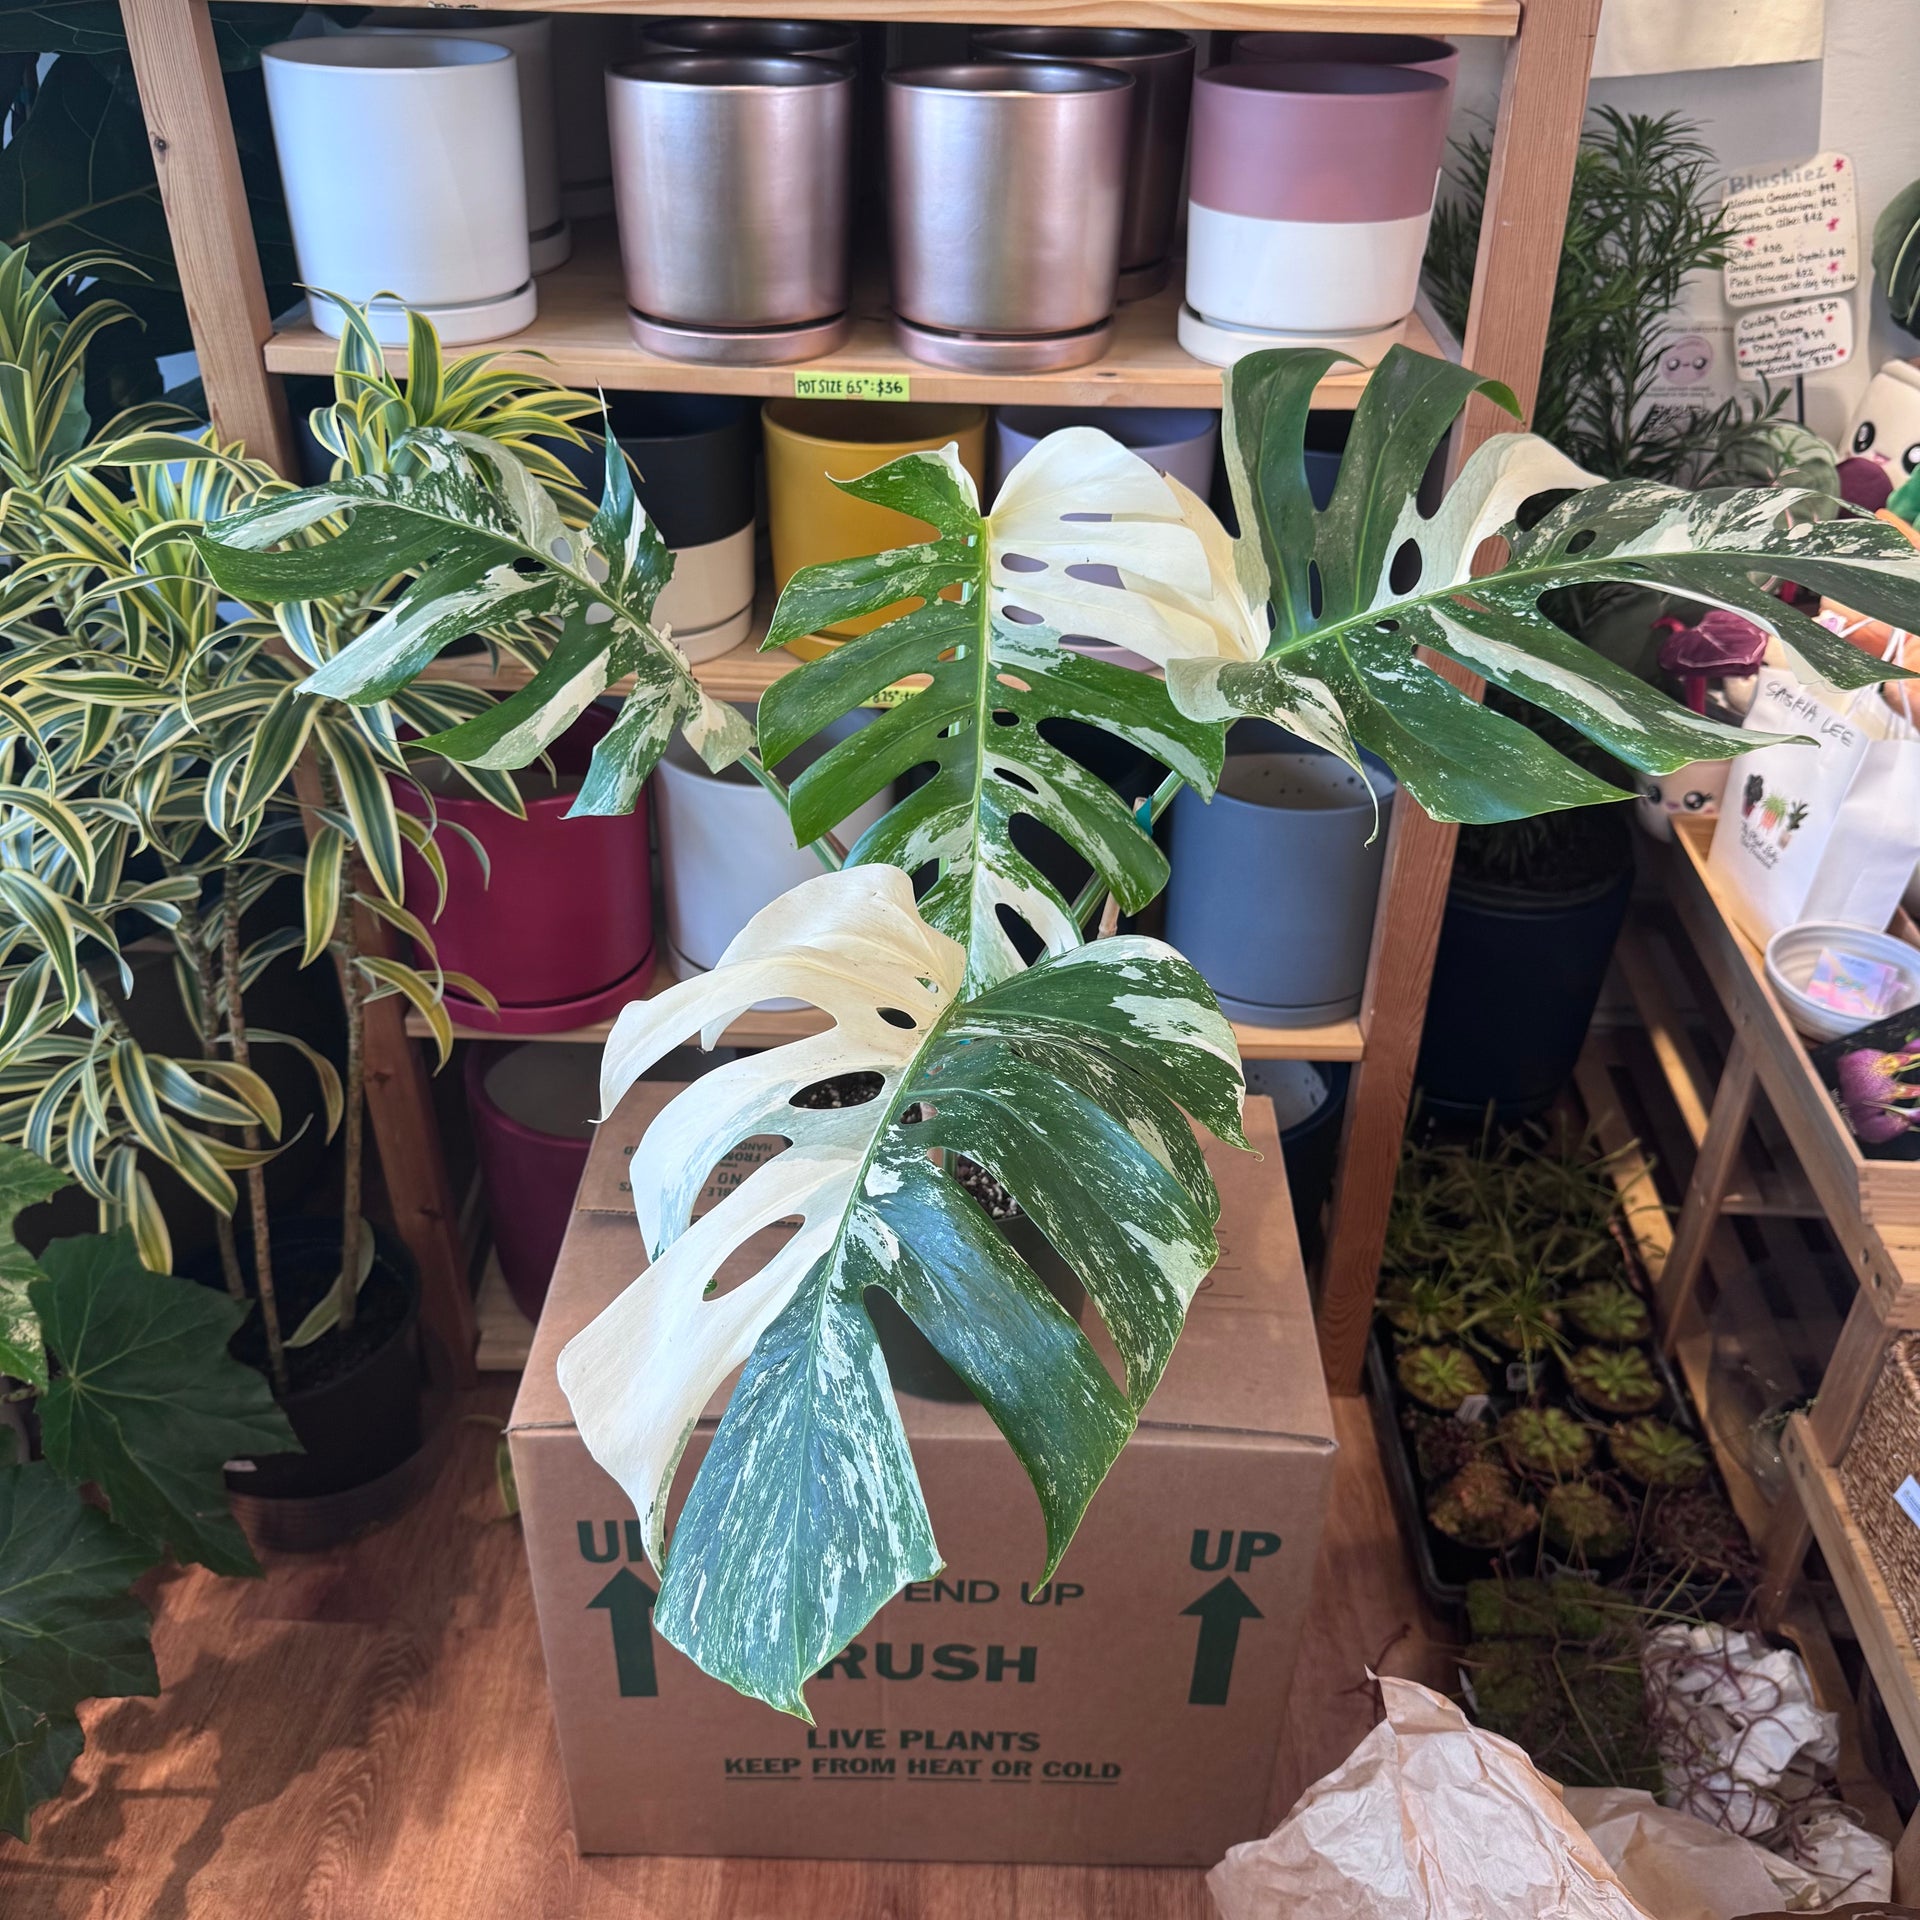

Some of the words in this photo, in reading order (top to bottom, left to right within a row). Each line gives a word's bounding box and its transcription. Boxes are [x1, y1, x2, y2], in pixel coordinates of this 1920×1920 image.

[798, 380, 816, 394] POT
[819, 379, 842, 394] SIZE
[1820, 715, 1855, 748] LEE
[1189, 1529, 1283, 1572] UP
[904, 1580, 1000, 1604] END
[1021, 1581, 1085, 1606] UP
[816, 1642, 1038, 1683] RUSH
[807, 1728, 887, 1750] LIVE
[900, 1729, 1041, 1752] PLANTS
[725, 1757, 801, 1775] KEEP
[813, 1757, 896, 1775] FROM
[907, 1758, 983, 1776] HEAT
[991, 1760, 1032, 1777] OR
[1042, 1761, 1122, 1779] COLD
